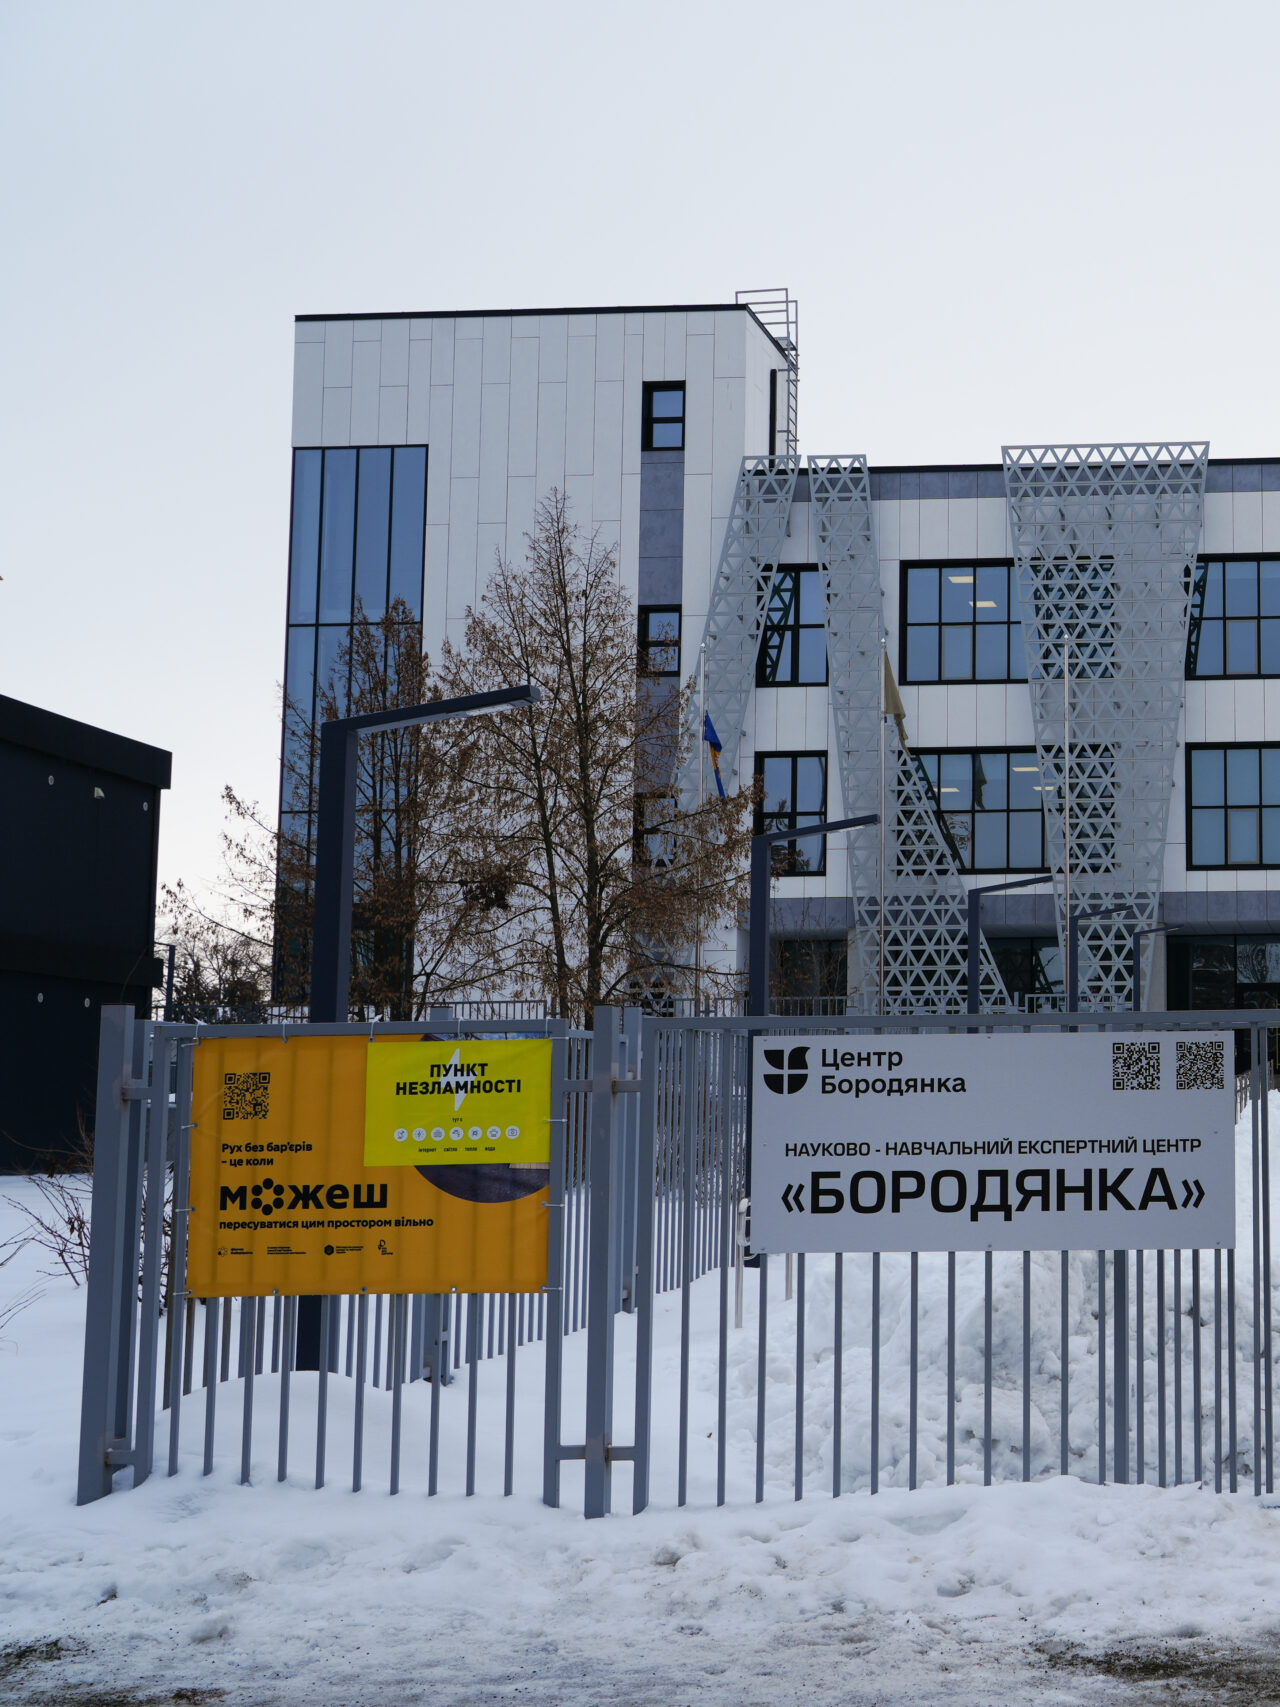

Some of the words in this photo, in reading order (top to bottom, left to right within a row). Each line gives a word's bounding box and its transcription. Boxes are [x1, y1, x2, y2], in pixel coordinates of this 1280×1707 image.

[821, 1048, 903, 1071] Центр
[429, 1062, 489, 1078] ПУНКТ
[395, 1078, 521, 1096] НЕЗЛАМНОСТІ
[821, 1073, 967, 1099] Бородянка
[221, 1143, 243, 1155] Рух
[244, 1142, 265, 1153] без
[785, 1142, 871, 1157] НАУКОВО
[885, 1137, 1013, 1156] НАВЧАЛЬНИЙ
[1018, 1136, 1138, 1155] ЕКСПЕРТНИЙ
[1142, 1138, 1202, 1156] ЦЕНТР
[229, 1158, 244, 1168] це
[245, 1158, 274, 1166] коли
[781, 1167, 1206, 1222] «БОРОДЯНКА»
[219, 1220, 299, 1231] пересуватися
[301, 1220, 325, 1230] цим
[327, 1219, 392, 1230] простором
[394, 1216, 434, 1227] вільно
